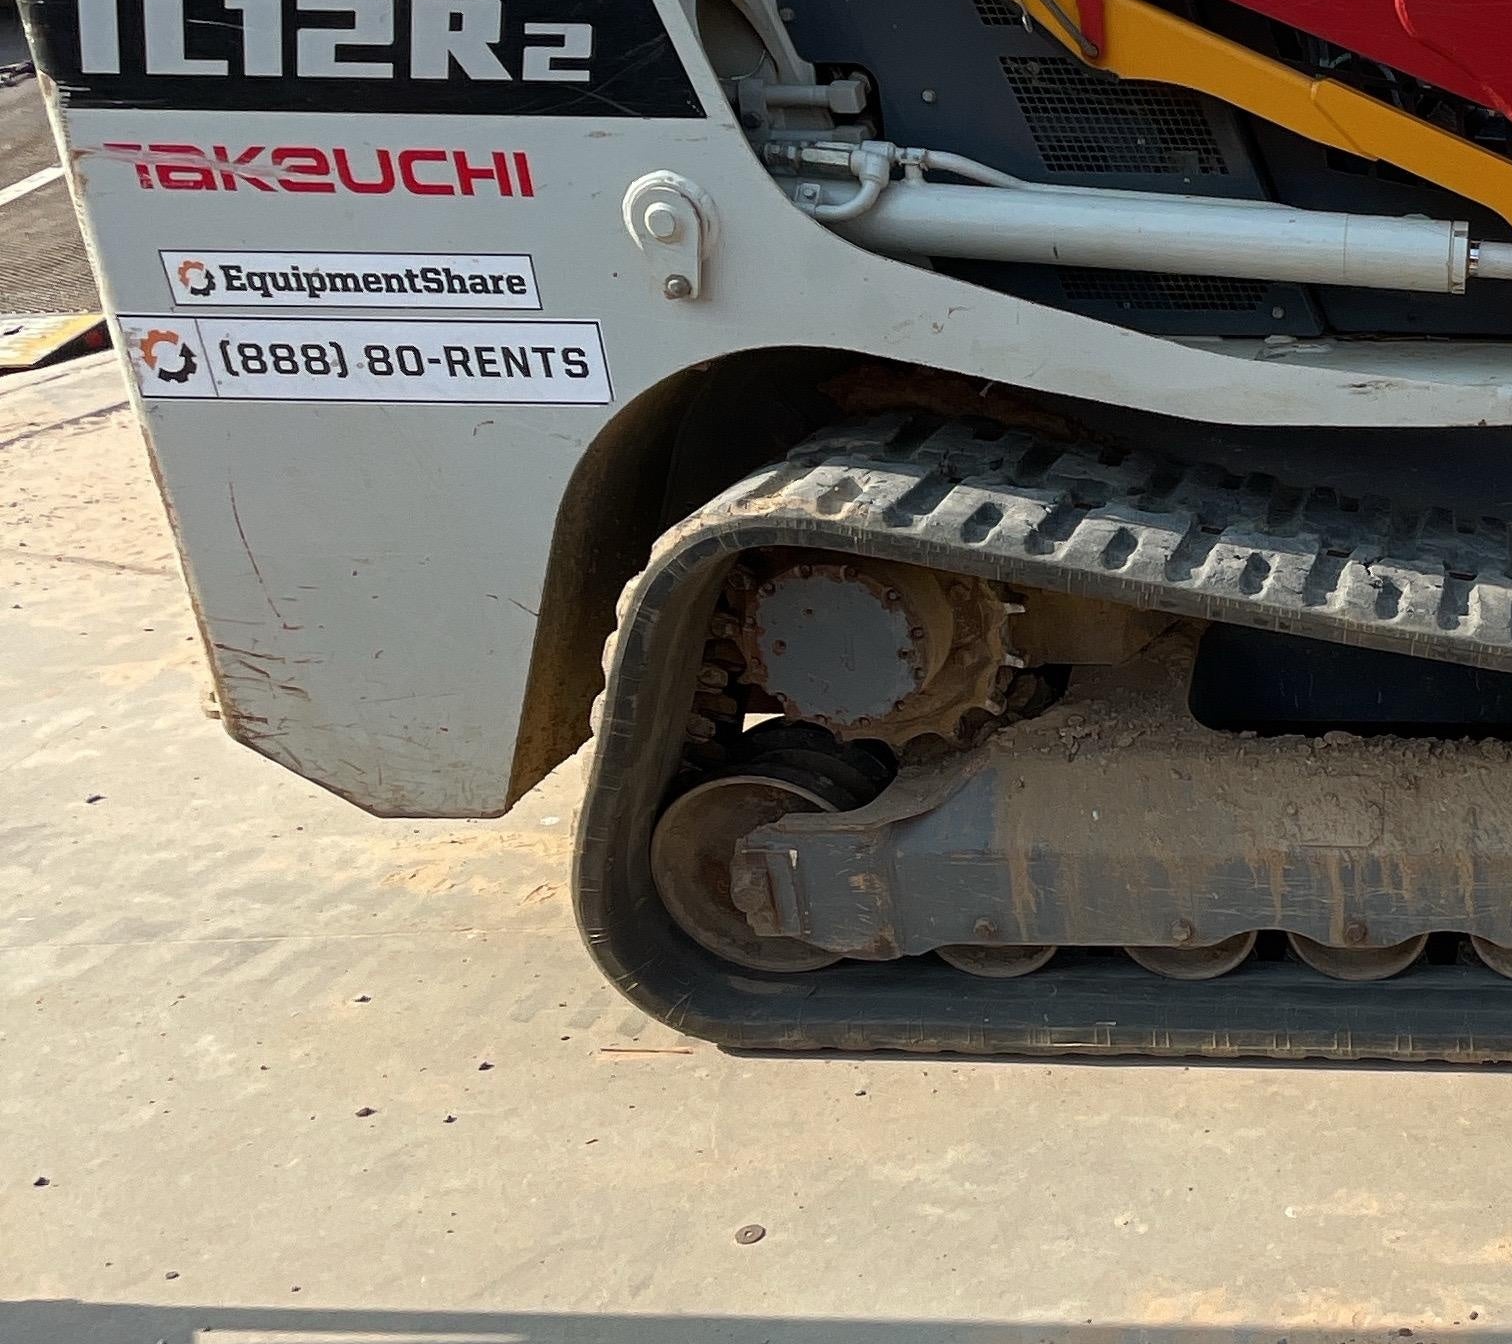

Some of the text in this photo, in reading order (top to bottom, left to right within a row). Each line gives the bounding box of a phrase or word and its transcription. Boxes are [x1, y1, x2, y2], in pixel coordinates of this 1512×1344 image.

[220, 264, 528, 299] EquipmentShare
[219, 339, 591, 380] (888) 80-RENTS
